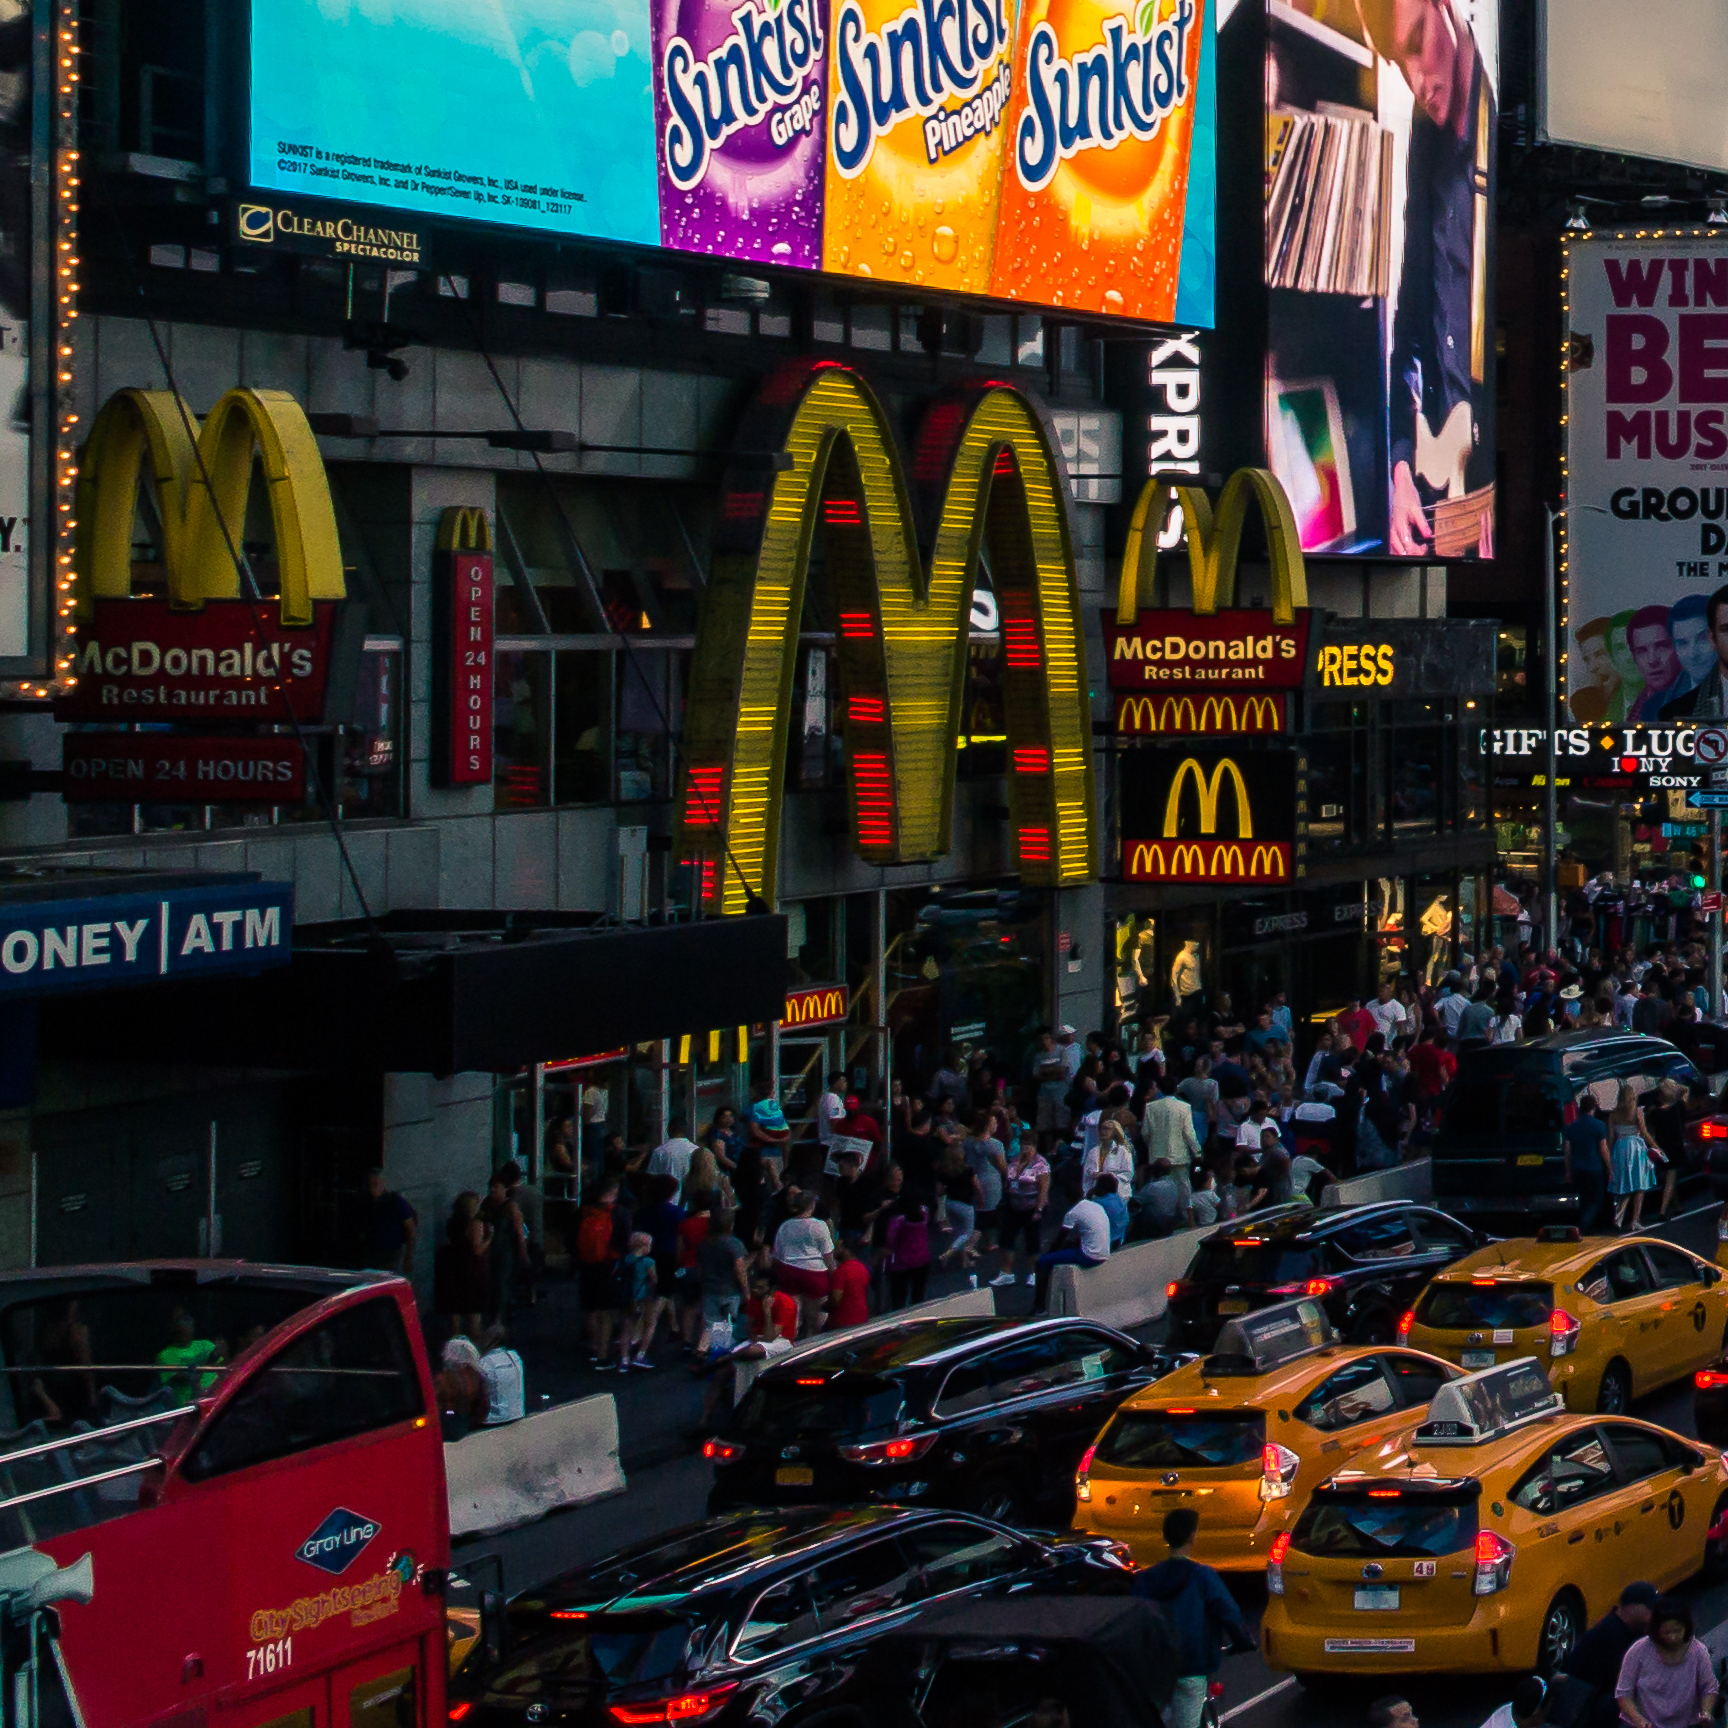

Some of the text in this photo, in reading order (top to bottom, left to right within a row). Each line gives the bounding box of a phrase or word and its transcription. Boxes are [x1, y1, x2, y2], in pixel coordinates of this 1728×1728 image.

[769, 87, 821, 149] Grape
[923, 72, 1012, 163] Pineapple
[277, 141, 314, 159] SUNKIST
[335, 241, 420, 262] SPECTACOLOR
[1677, 562, 1710, 577] THE
[71, 639, 314, 679] McDonald's
[1114, 634, 1297, 661] McDonald's
[465, 564, 486, 773] OPEN 24 HOURS
[1144, 664, 1266, 680] Restaurant
[102, 682, 272, 709] Restaurant
[70, 758, 294, 783] OPEN 24 HOURS
[1611, 757, 1673, 773] I NY
[1649, 776, 1702, 788] SONY
[180, 905, 282, 957] ATM
[1254, 911, 1308, 935] EXPRESS
[246, 1636, 293, 1681] 71611
